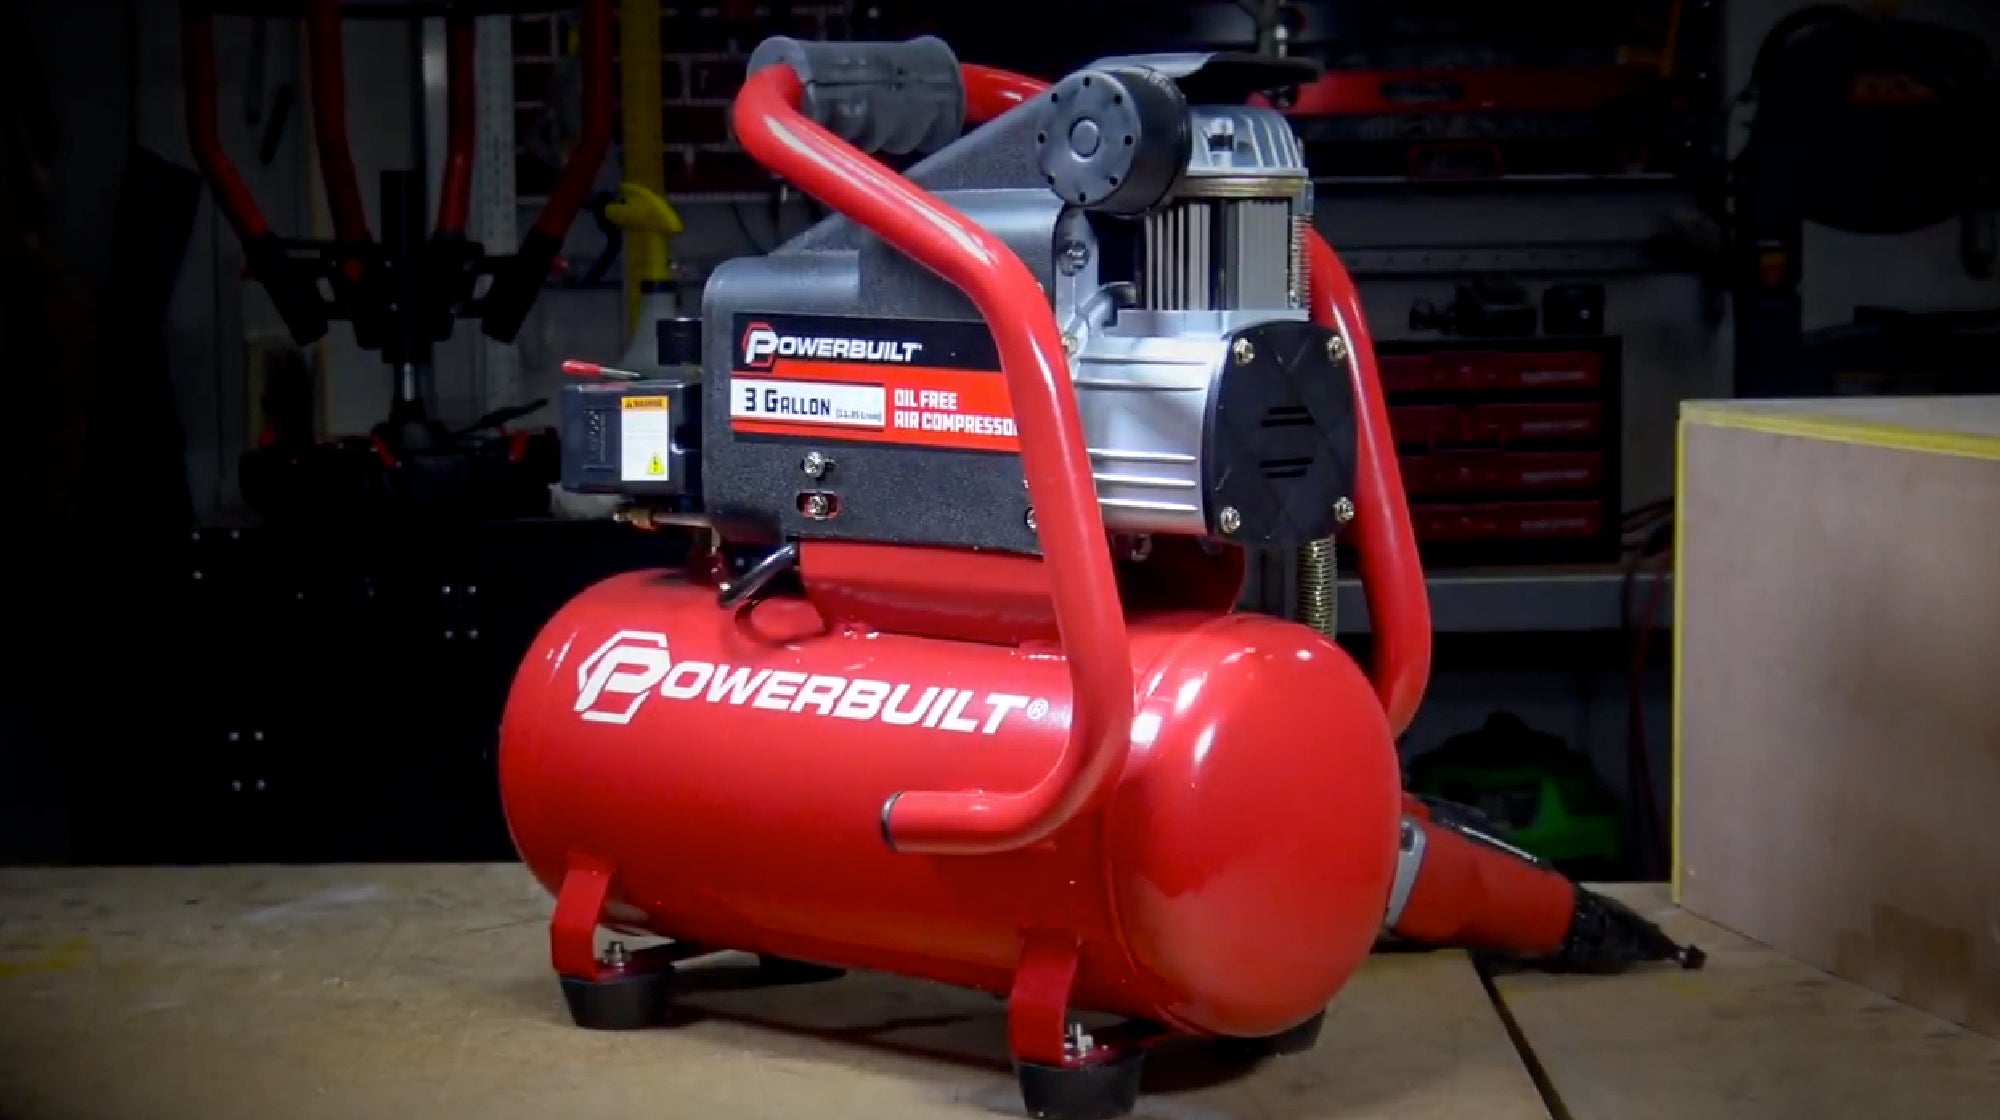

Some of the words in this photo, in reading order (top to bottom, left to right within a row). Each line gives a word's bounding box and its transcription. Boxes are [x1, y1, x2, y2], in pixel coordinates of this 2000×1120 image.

[744, 329, 920, 362] POWERBUILT
[744, 387, 756, 412] 3
[764, 387, 831, 416] GALLON
[894, 388, 918, 408] OIL
[920, 389, 957, 411] FREE
[894, 410, 919, 429] AIR
